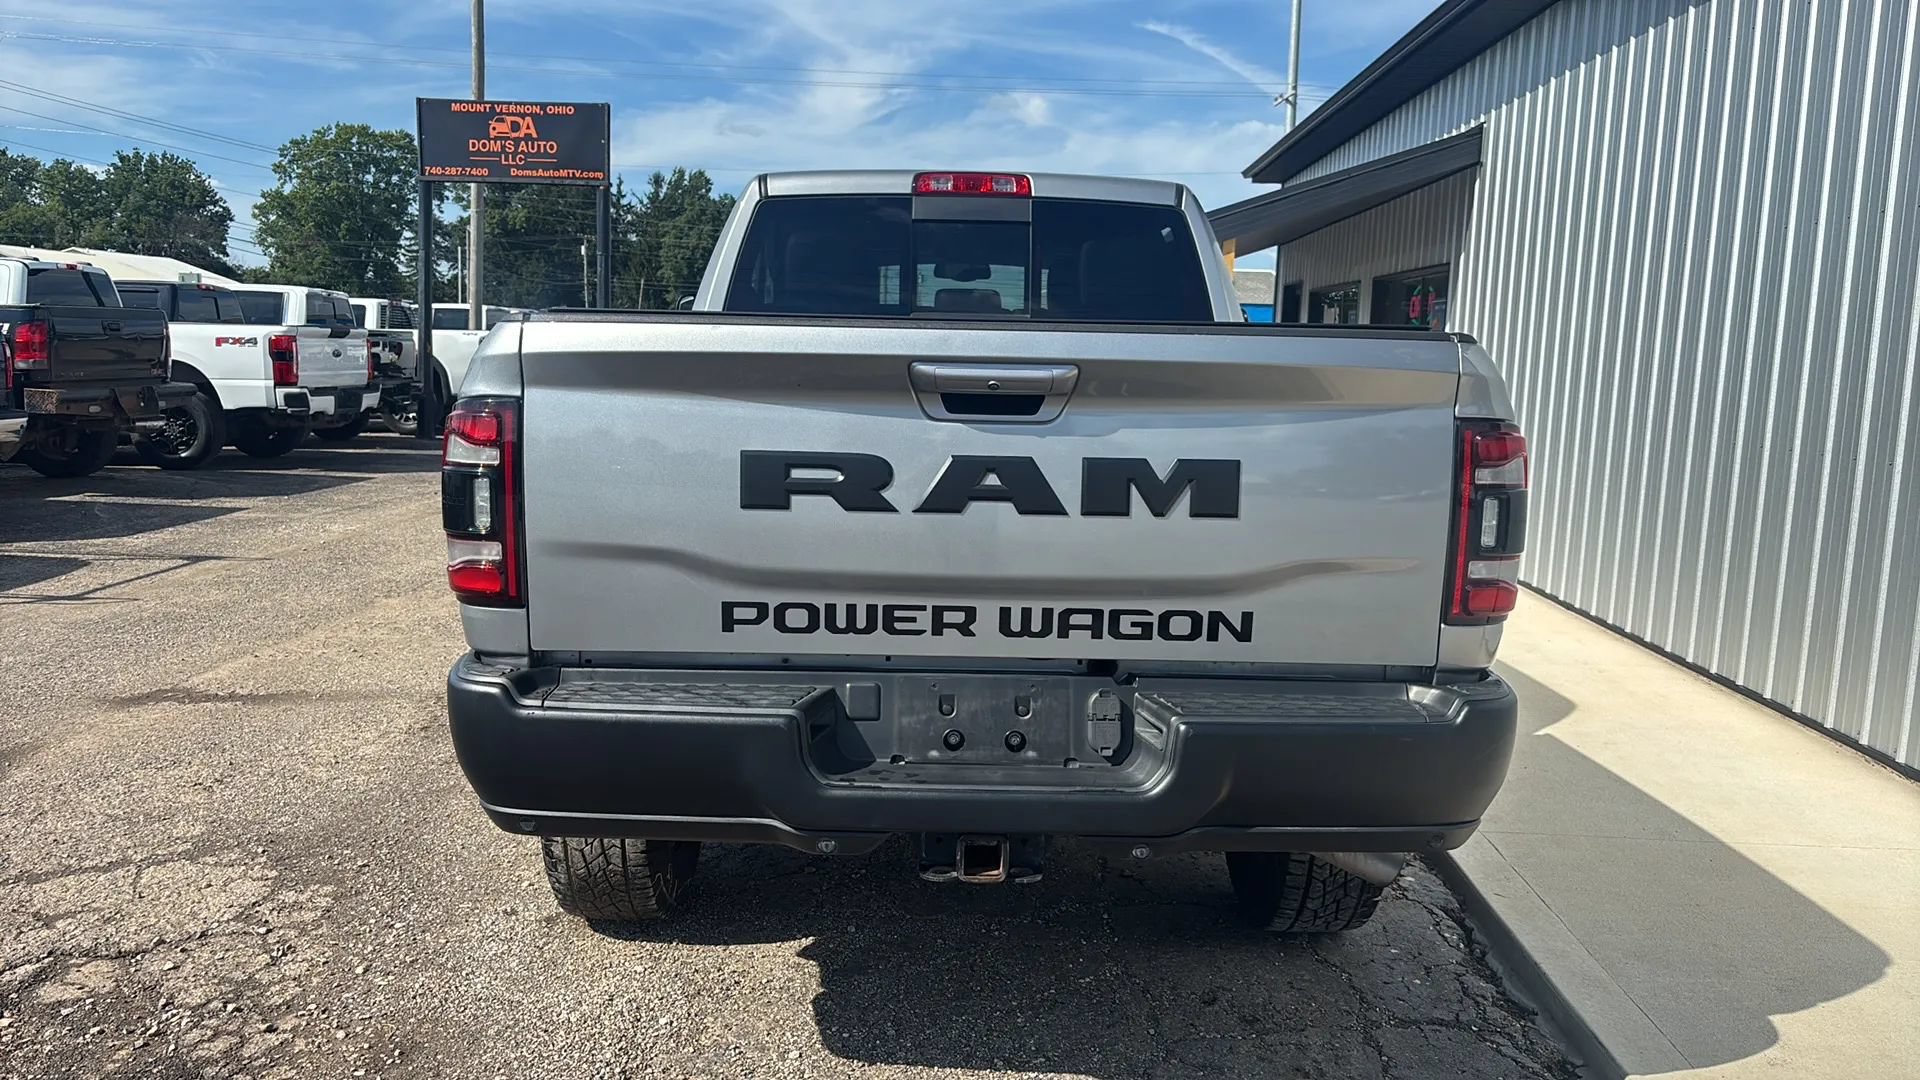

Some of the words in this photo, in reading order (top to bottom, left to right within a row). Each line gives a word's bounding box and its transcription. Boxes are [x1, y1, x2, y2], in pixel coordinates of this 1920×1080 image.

[451, 103, 492, 113] MOUNT
[494, 104, 544, 115] VERNON,
[547, 105, 575, 115] OHIO
[469, 139, 515, 152] DOM'S
[518, 140, 558, 154] AUTO
[501, 154, 525, 165] LLC
[424, 166, 489, 176] 740-287-7400
[510, 168, 604, 180] DomsAutoMTV.com
[215, 336, 258, 347] FX4
[740, 450, 1242, 519] RAM
[721, 601, 977, 638] POWER
[998, 606, 1254, 643] WAGON
